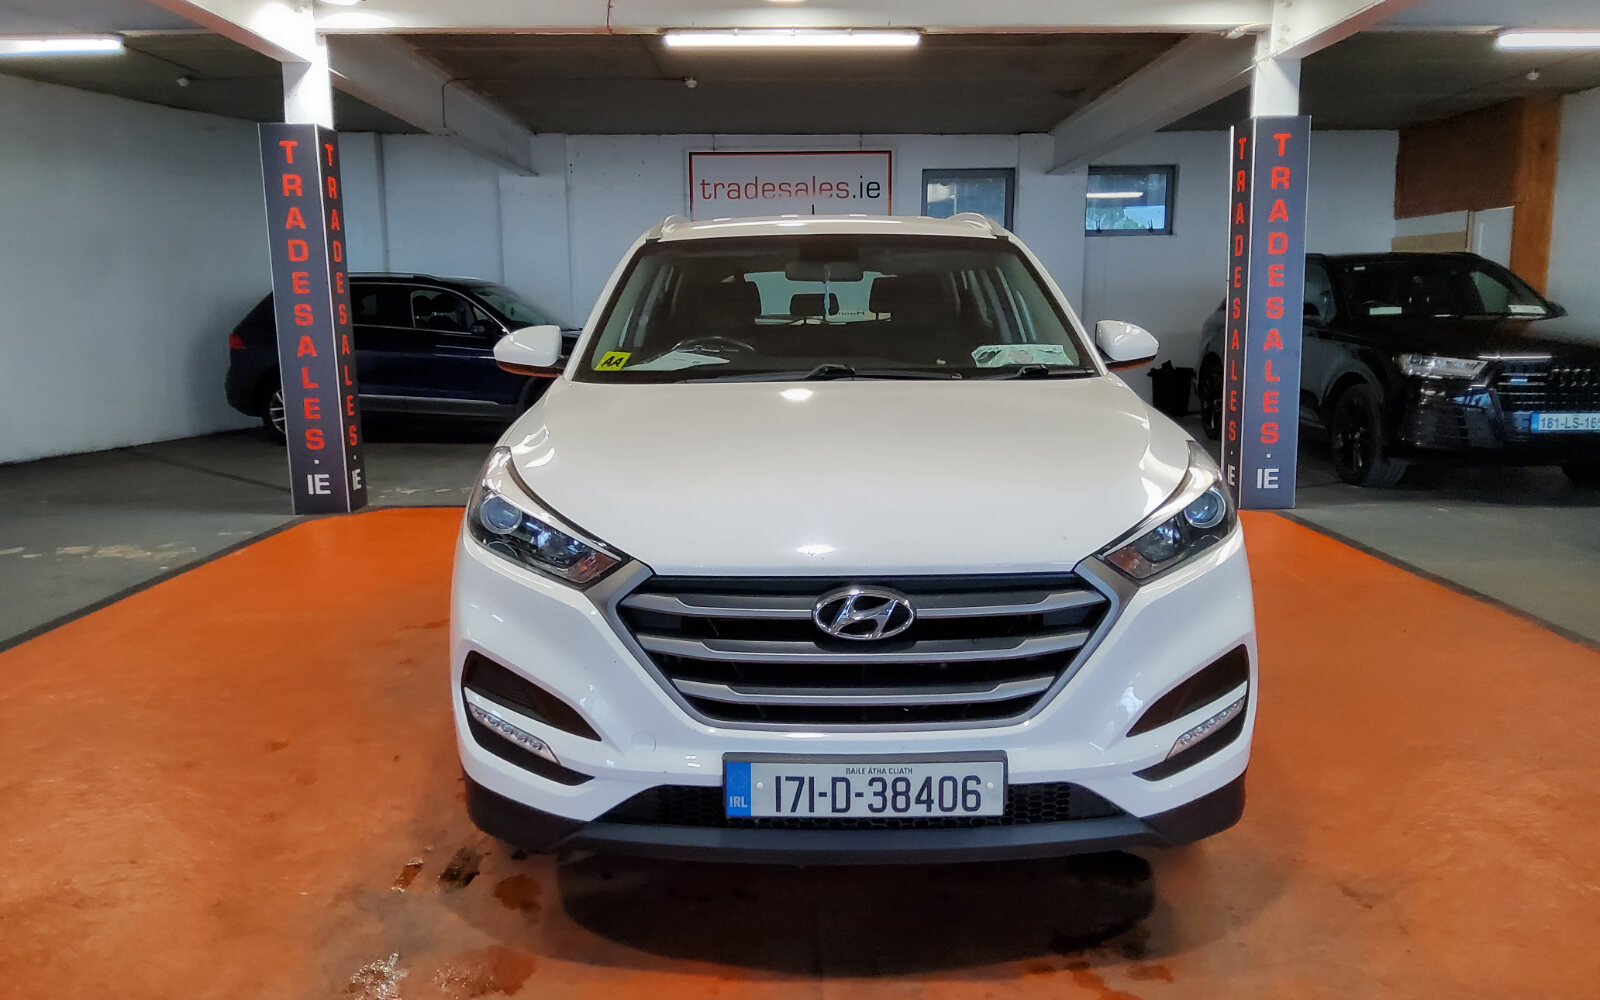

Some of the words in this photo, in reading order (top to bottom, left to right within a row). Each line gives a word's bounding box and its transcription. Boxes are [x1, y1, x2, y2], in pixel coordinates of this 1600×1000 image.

[700, 175, 881, 200] tradesales.ie
[600, 356, 623, 367] AA
[845, 767, 866, 775] BAILE
[868, 766, 887, 775] ÁTHA
[888, 767, 913, 775] CLIATH
[775, 775, 982, 813] 171-D-38406
[729, 796, 748, 808] IRL
